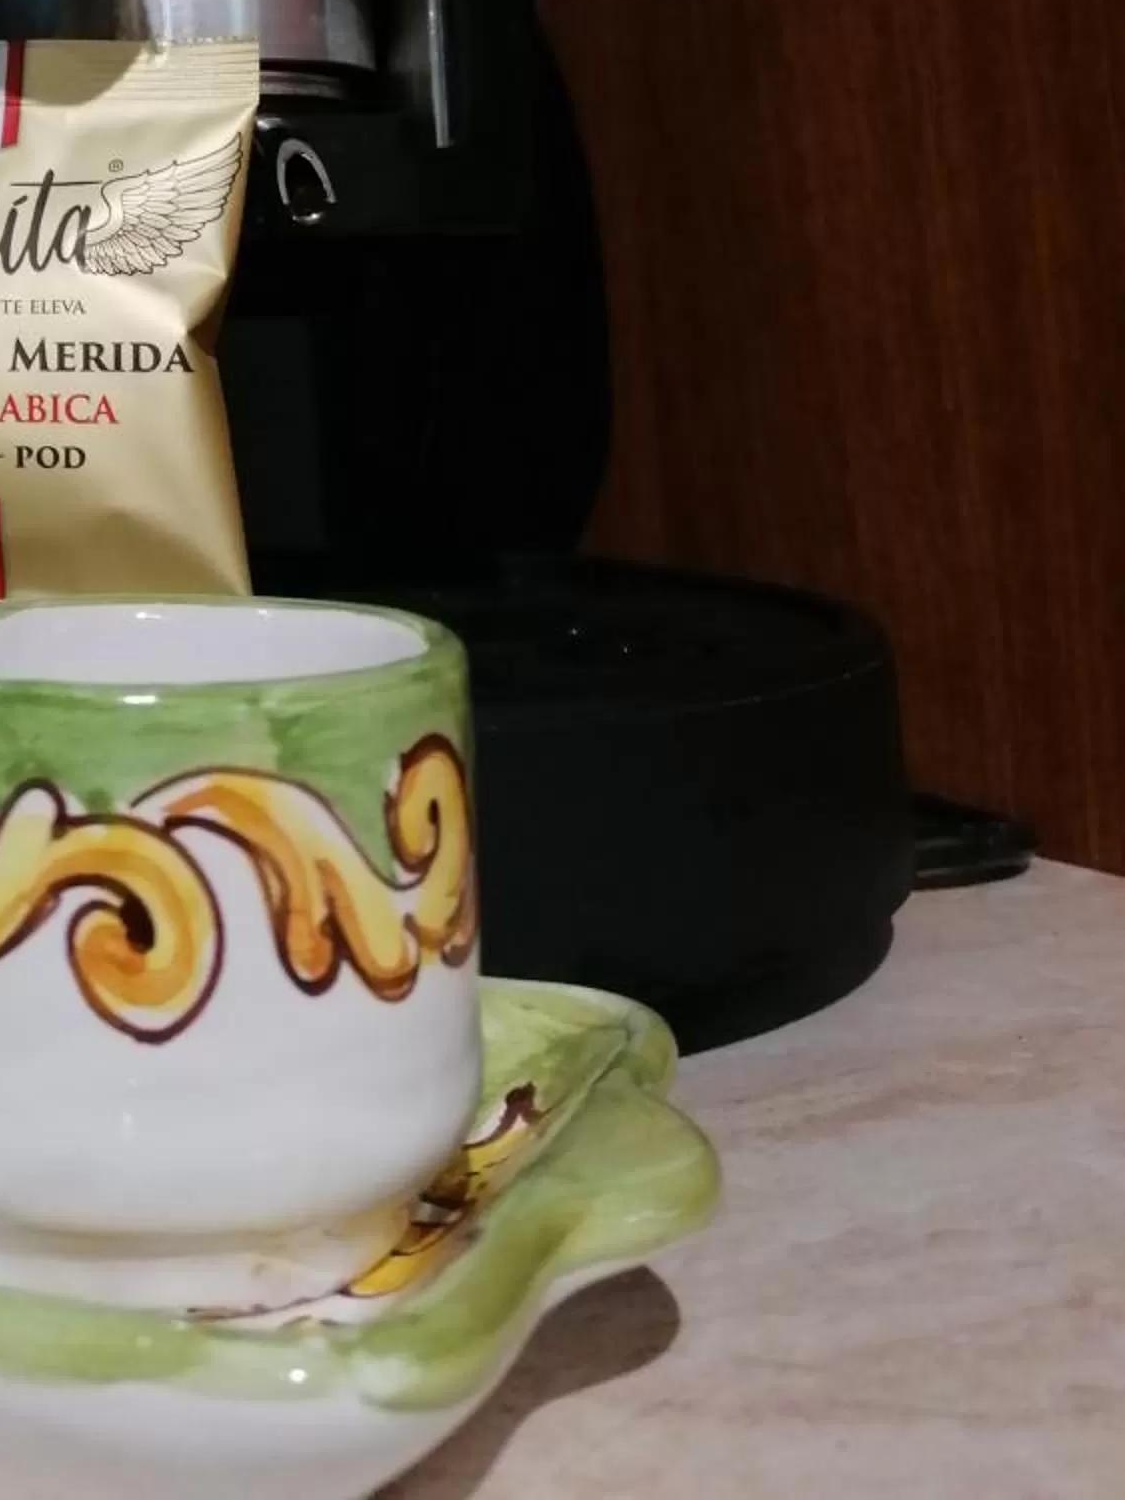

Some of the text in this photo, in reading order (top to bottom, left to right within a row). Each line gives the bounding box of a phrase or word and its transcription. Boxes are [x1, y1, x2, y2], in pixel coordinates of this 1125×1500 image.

[1, 299, 23, 316] TE
[29, 299, 88, 316] ELEVA
[7, 337, 195, 375] MERIDA
[15, 445, 88, 470] POD
